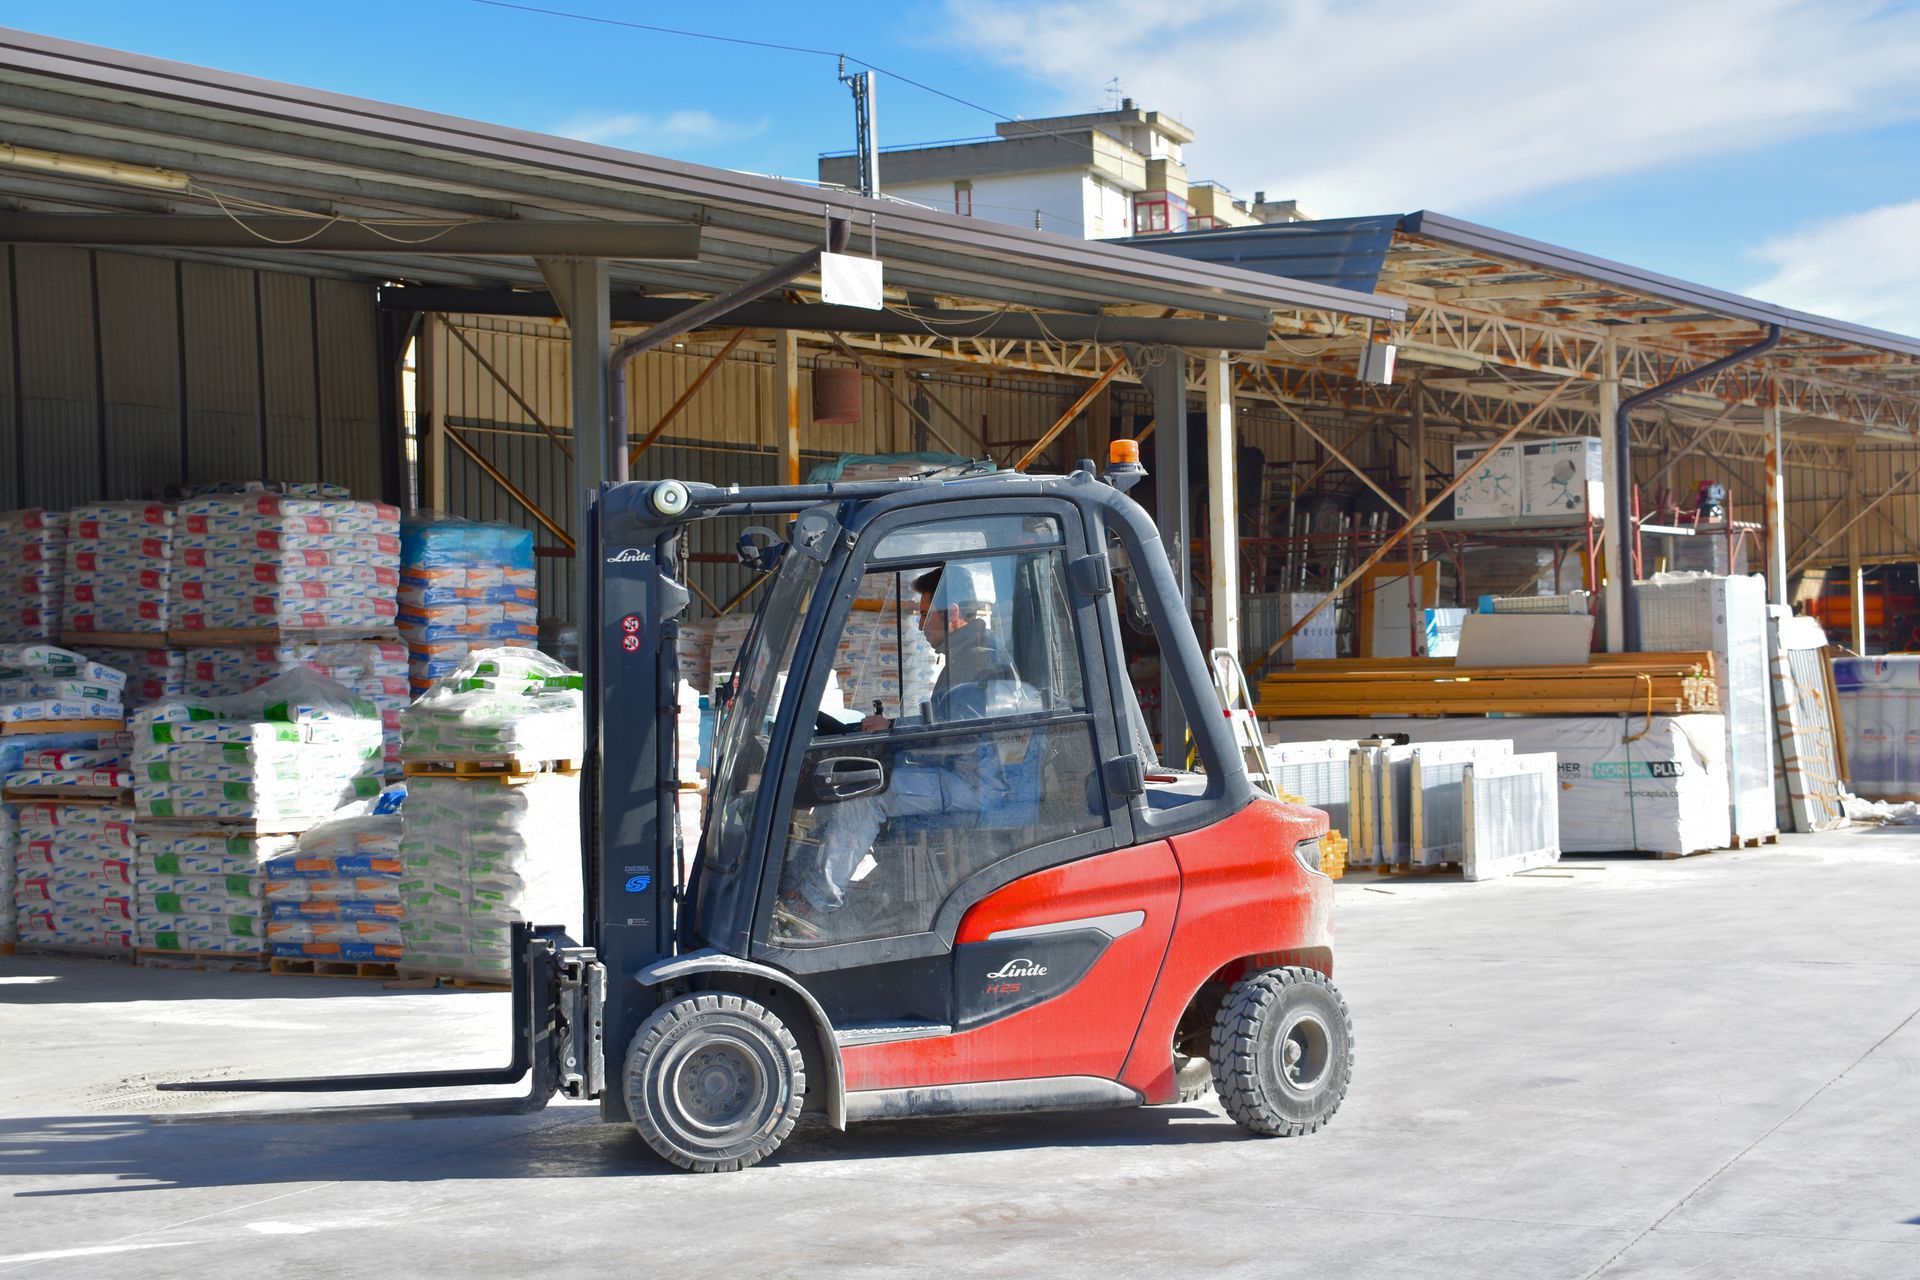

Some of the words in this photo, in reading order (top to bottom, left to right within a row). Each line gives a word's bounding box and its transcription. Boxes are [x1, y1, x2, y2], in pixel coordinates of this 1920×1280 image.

[607, 548, 651, 562] Linde
[1595, 763, 1649, 777] NORICA
[1624, 788, 1679, 799] noricaplus.co
[987, 958, 1048, 978] Linde
